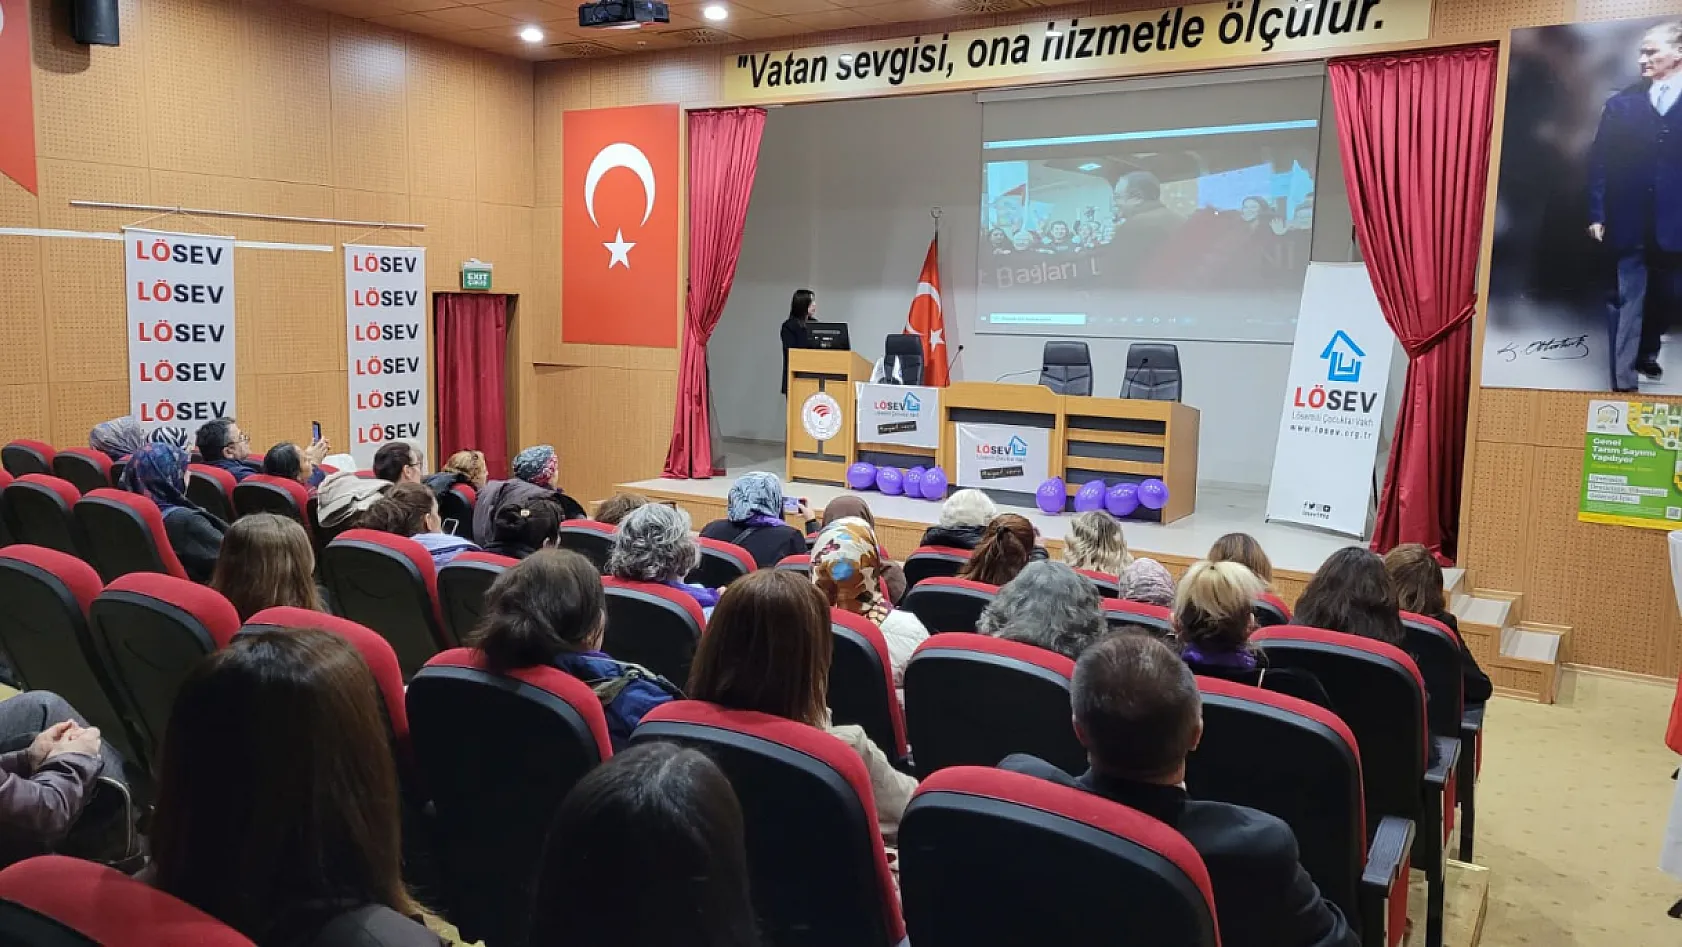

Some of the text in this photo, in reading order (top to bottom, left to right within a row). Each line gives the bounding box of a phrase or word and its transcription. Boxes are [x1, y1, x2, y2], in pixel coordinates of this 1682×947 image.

[737, 52, 827, 88] "Vatan
[836, 33, 954, 85] sevgisi,
[967, 34, 1031, 69] ona
[1041, 7, 1205, 62] hizmetle
[136, 238, 223, 265] LÖSEV
[353, 252, 417, 273] LÖSEV
[467, 272, 488, 280] EXIT
[137, 279, 224, 304] LÖSEV
[354, 287, 418, 306] LÖSEV
[138, 319, 225, 342] LÖSEV
[355, 321, 419, 341] LÖSEV
[140, 359, 226, 381] LÖSEV
[356, 355, 420, 375] LÖSEV
[357, 389, 420, 410] LÖSEV
[1294, 384, 1378, 413] LÖSEV
[141, 399, 227, 422] LÖSEV
[358, 421, 421, 444] LÖSEV
[1593, 438, 1621, 446] Genel
